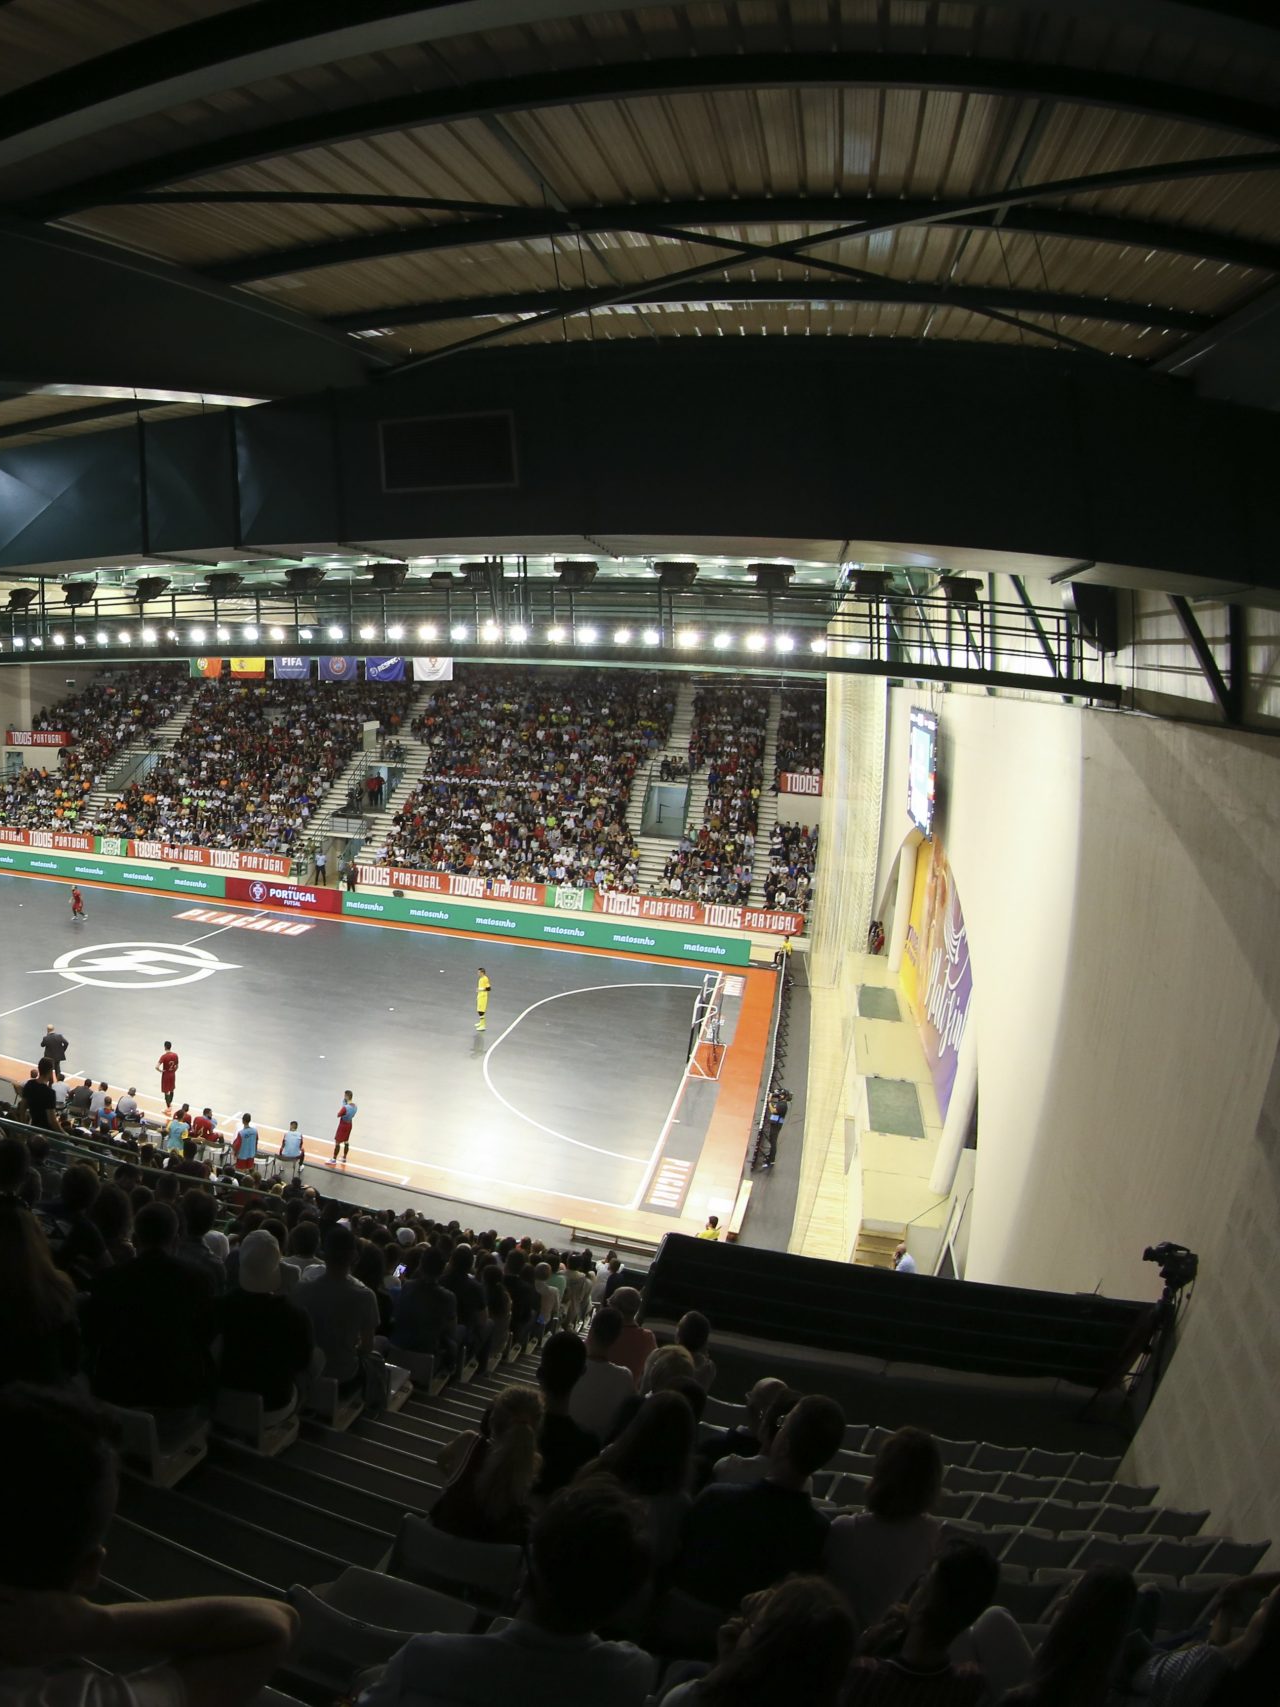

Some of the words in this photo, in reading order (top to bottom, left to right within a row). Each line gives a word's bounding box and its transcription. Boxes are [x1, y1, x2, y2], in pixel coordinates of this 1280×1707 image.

[282, 657, 303, 666] FIFA
[11, 732, 32, 745] TODOS
[32, 733, 63, 744] PORTUGAL
[786, 773, 819, 794] TODOS
[29, 830, 53, 848] TODOS
[54, 836, 89, 850] PORTUGAL
[133, 841, 162, 860] TODOS
[209, 849, 240, 870] TODOS
[241, 855, 284, 873] PORTUGAL
[356, 864, 390, 886] TODOS
[392, 871, 441, 890] PORTUGAL
[448, 875, 484, 898] TODOS
[269, 888, 317, 903] PORTUGAL
[174, 909, 313, 936] PLACARD
[602, 893, 640, 916] TODOS
[642, 899, 696, 920] PORTUGAL
[703, 904, 742, 929] TODOS
[744, 912, 798, 932] PORTUGAL
[650, 1157, 691, 1208] PLACARD
